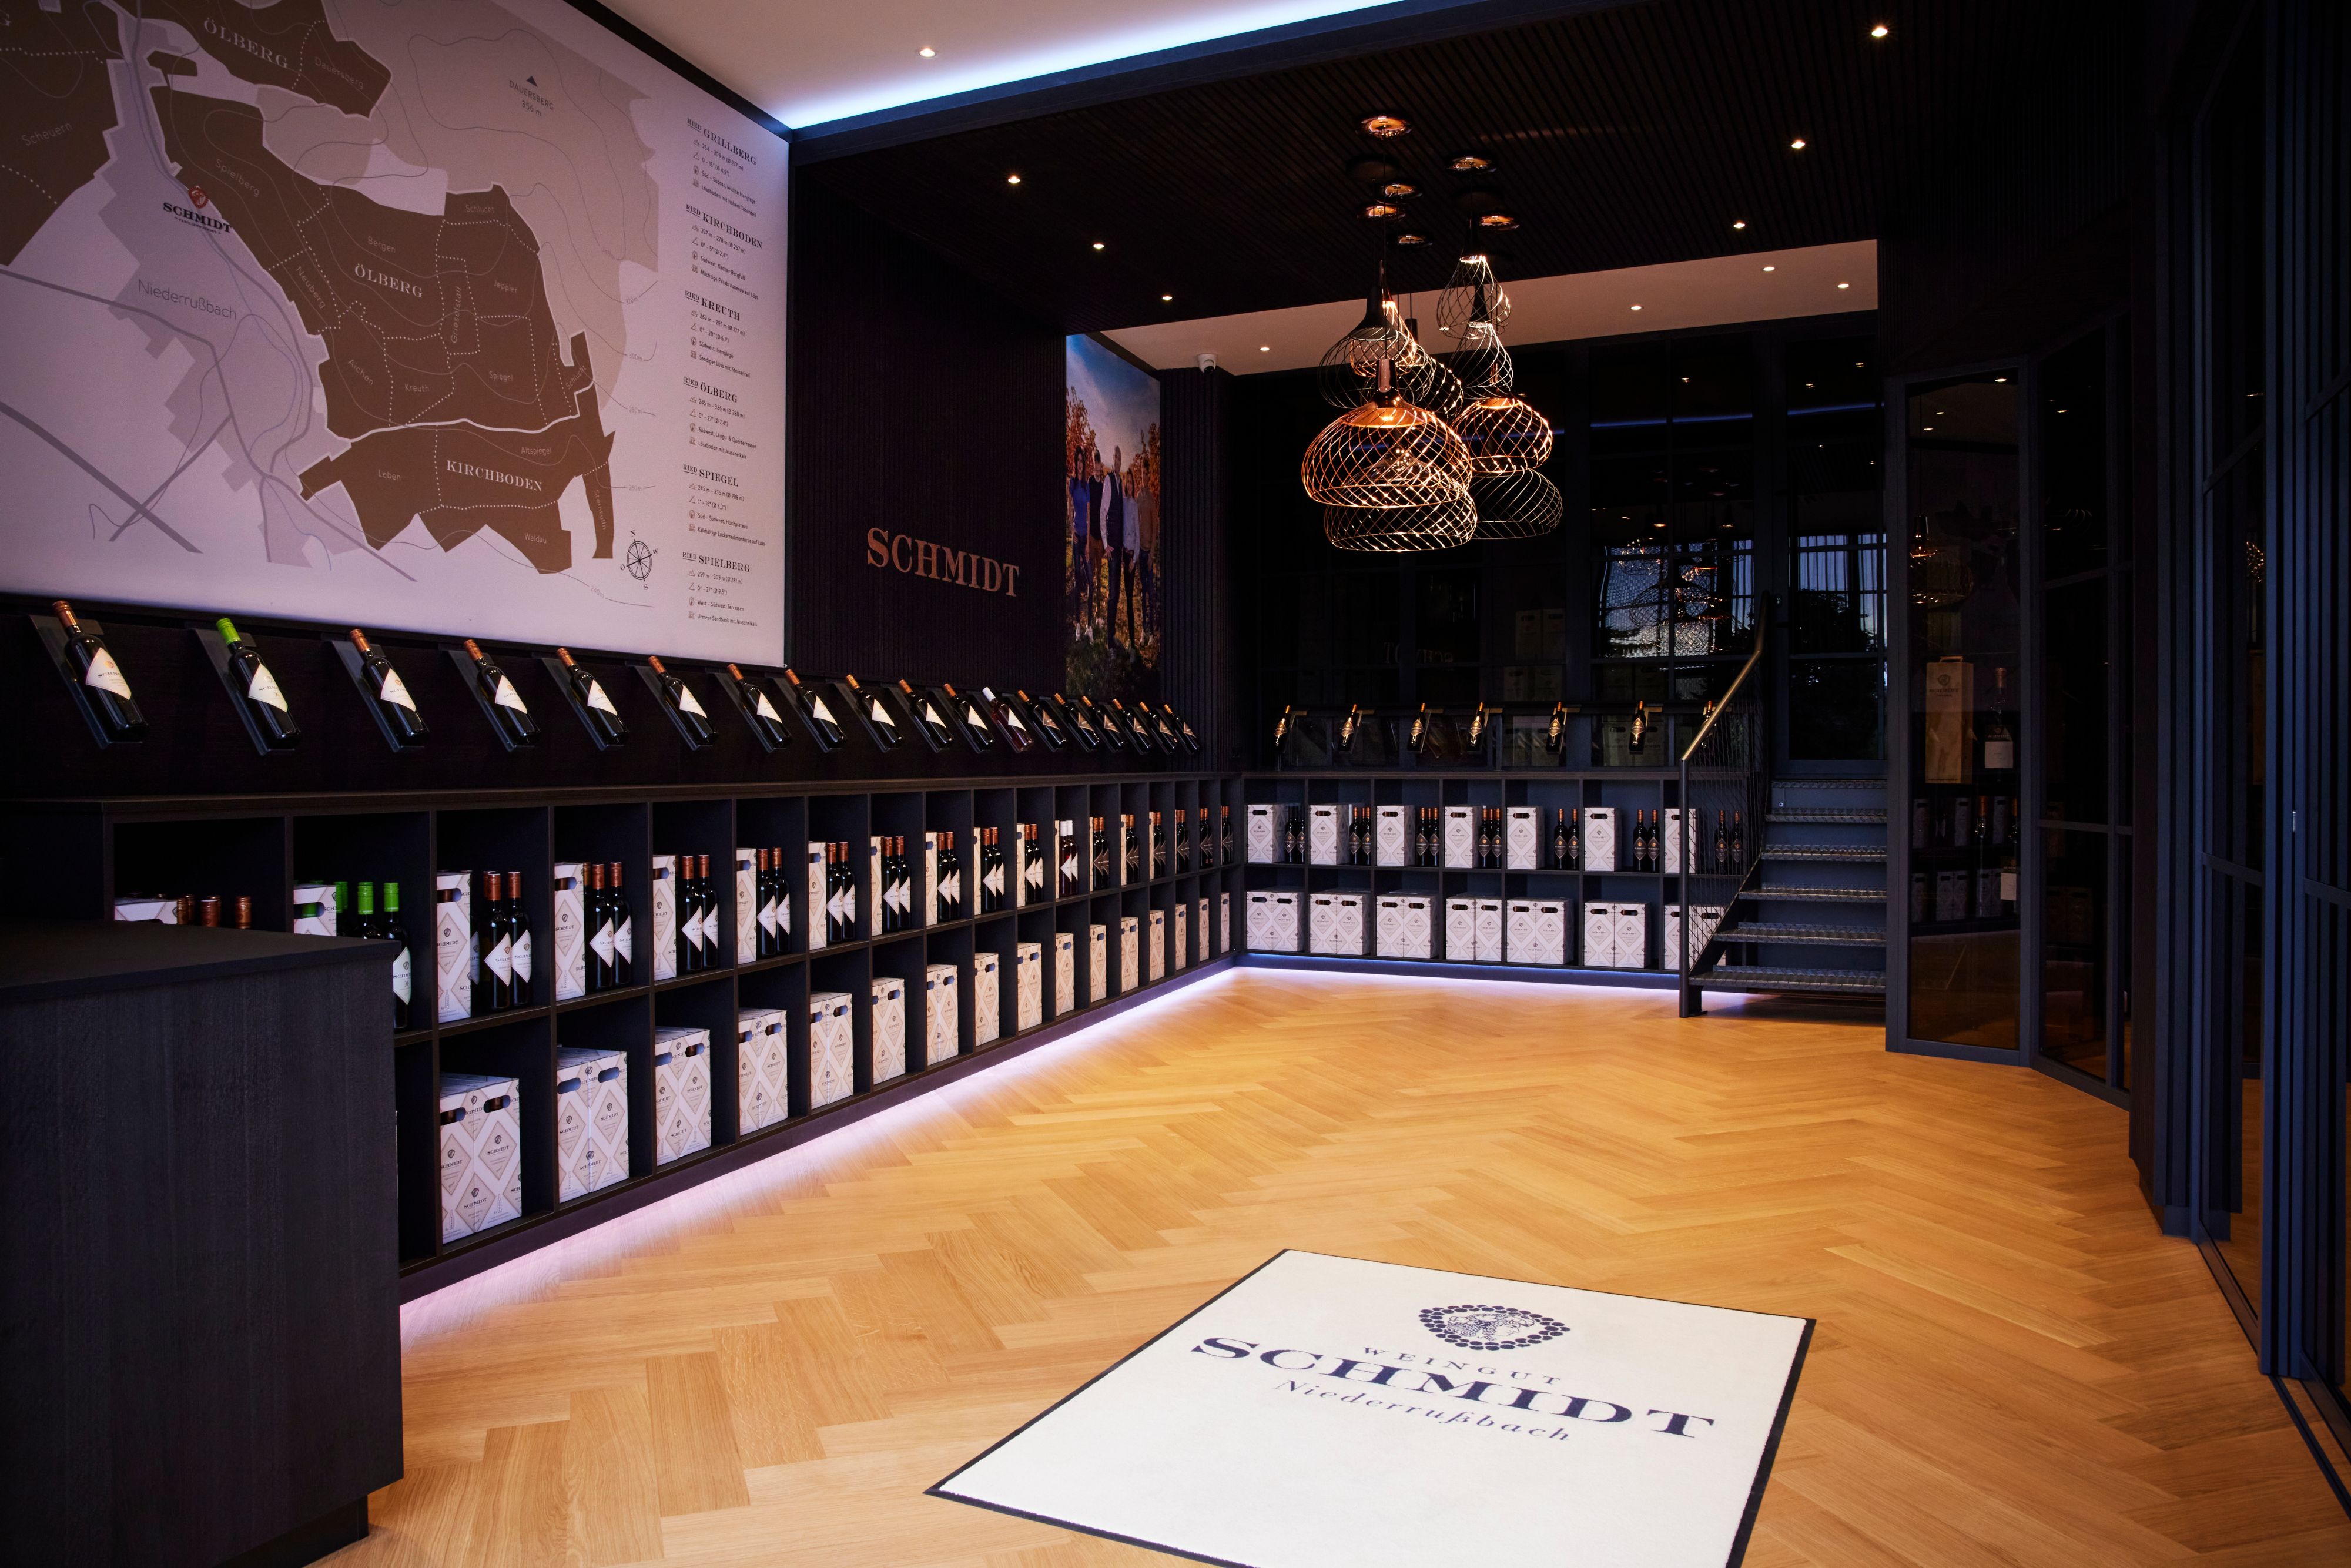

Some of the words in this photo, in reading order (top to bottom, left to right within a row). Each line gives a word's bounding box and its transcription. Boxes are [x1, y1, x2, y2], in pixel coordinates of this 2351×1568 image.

[203, 17, 287, 68] ÖLBERG
[314, 57, 363, 89] Dauersberg
[509, 79, 554, 110] DAUERSBERG
[521, 100, 533, 112] 356
[21, 122, 73, 146] Scheuern
[687, 118, 701, 130] RIED
[704, 128, 756, 165] GRILLBERG
[216, 158, 259, 197] Spielberg
[163, 202, 231, 233] SCHMIDT
[465, 204, 494, 213] Schlucht
[686, 203, 700, 215] RIED
[702, 212, 762, 249] KIRCHBODEN
[367, 236, 395, 253] Bergen
[295, 266, 326, 309] Neuberg
[355, 263, 423, 298] ÖLBERG
[493, 280, 517, 293] Jeppler
[138, 279, 236, 320] Niederrußbach
[685, 290, 699, 300] RIED
[701, 297, 739, 321] KREUTH
[450, 286, 461, 343] Grieselstall
[347, 359, 374, 385] Aichen
[488, 370, 513, 382] Spiegel
[565, 364, 586, 390] Schlucht
[404, 383, 429, 392] Kreuth
[684, 377, 698, 386] RIED
[701, 381, 738, 403] ÖLBERG
[521, 447, 552, 455] Altspiegel
[377, 470, 401, 480] Leben
[447, 460, 542, 491] KIRCHBODEN
[683, 464, 697, 473] RIED
[699, 469, 739, 487] SPIEGEL
[524, 532, 547, 544] Waldau
[699, 556, 750, 572] SPIELBERG
[867, 527, 1020, 597] SCHMIDT
[728, 603, 744, 611] Terrassen
[601, 1112, 618, 1121] SCHMIDT
[487, 1145, 508, 1155] SCHMIDT
[464, 1198, 487, 1209] SCHMIDT
[1362, 1347, 1562, 1386] WEINGUT
[1191, 1337, 1715, 1438] SCHMIDT
[1272, 1379, 1570, 1441] Niederrußbach
